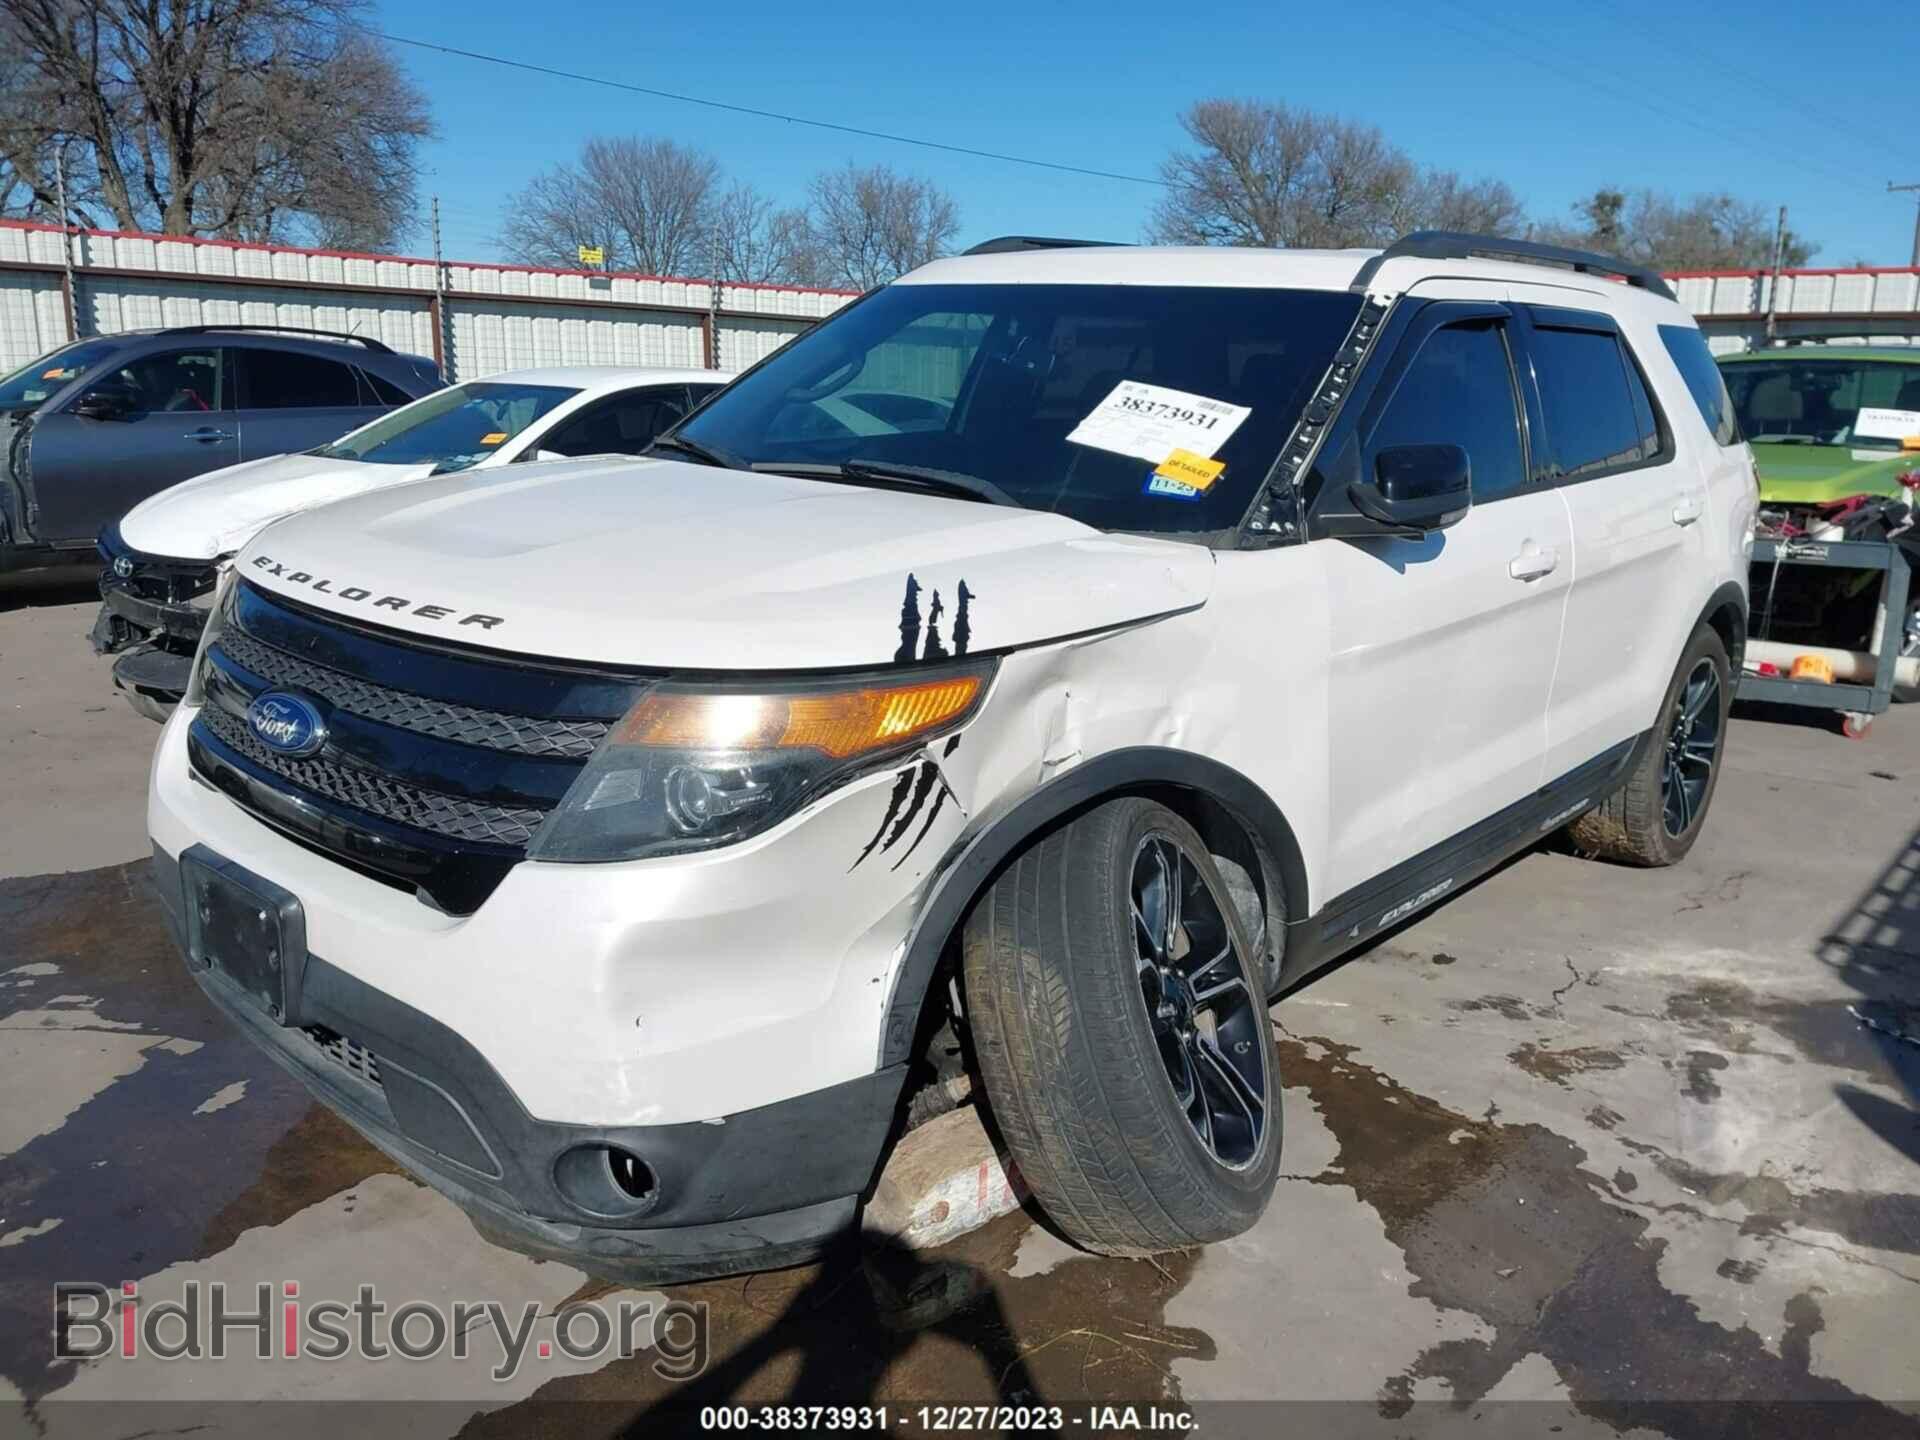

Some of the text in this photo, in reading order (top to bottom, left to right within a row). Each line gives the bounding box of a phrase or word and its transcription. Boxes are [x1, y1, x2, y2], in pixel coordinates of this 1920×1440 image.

[1113, 396, 1219, 430] 38373931
[1168, 459, 1210, 479] DETAILED
[251, 556, 505, 630] EXPLORER
[255, 701, 299, 744] Ford
